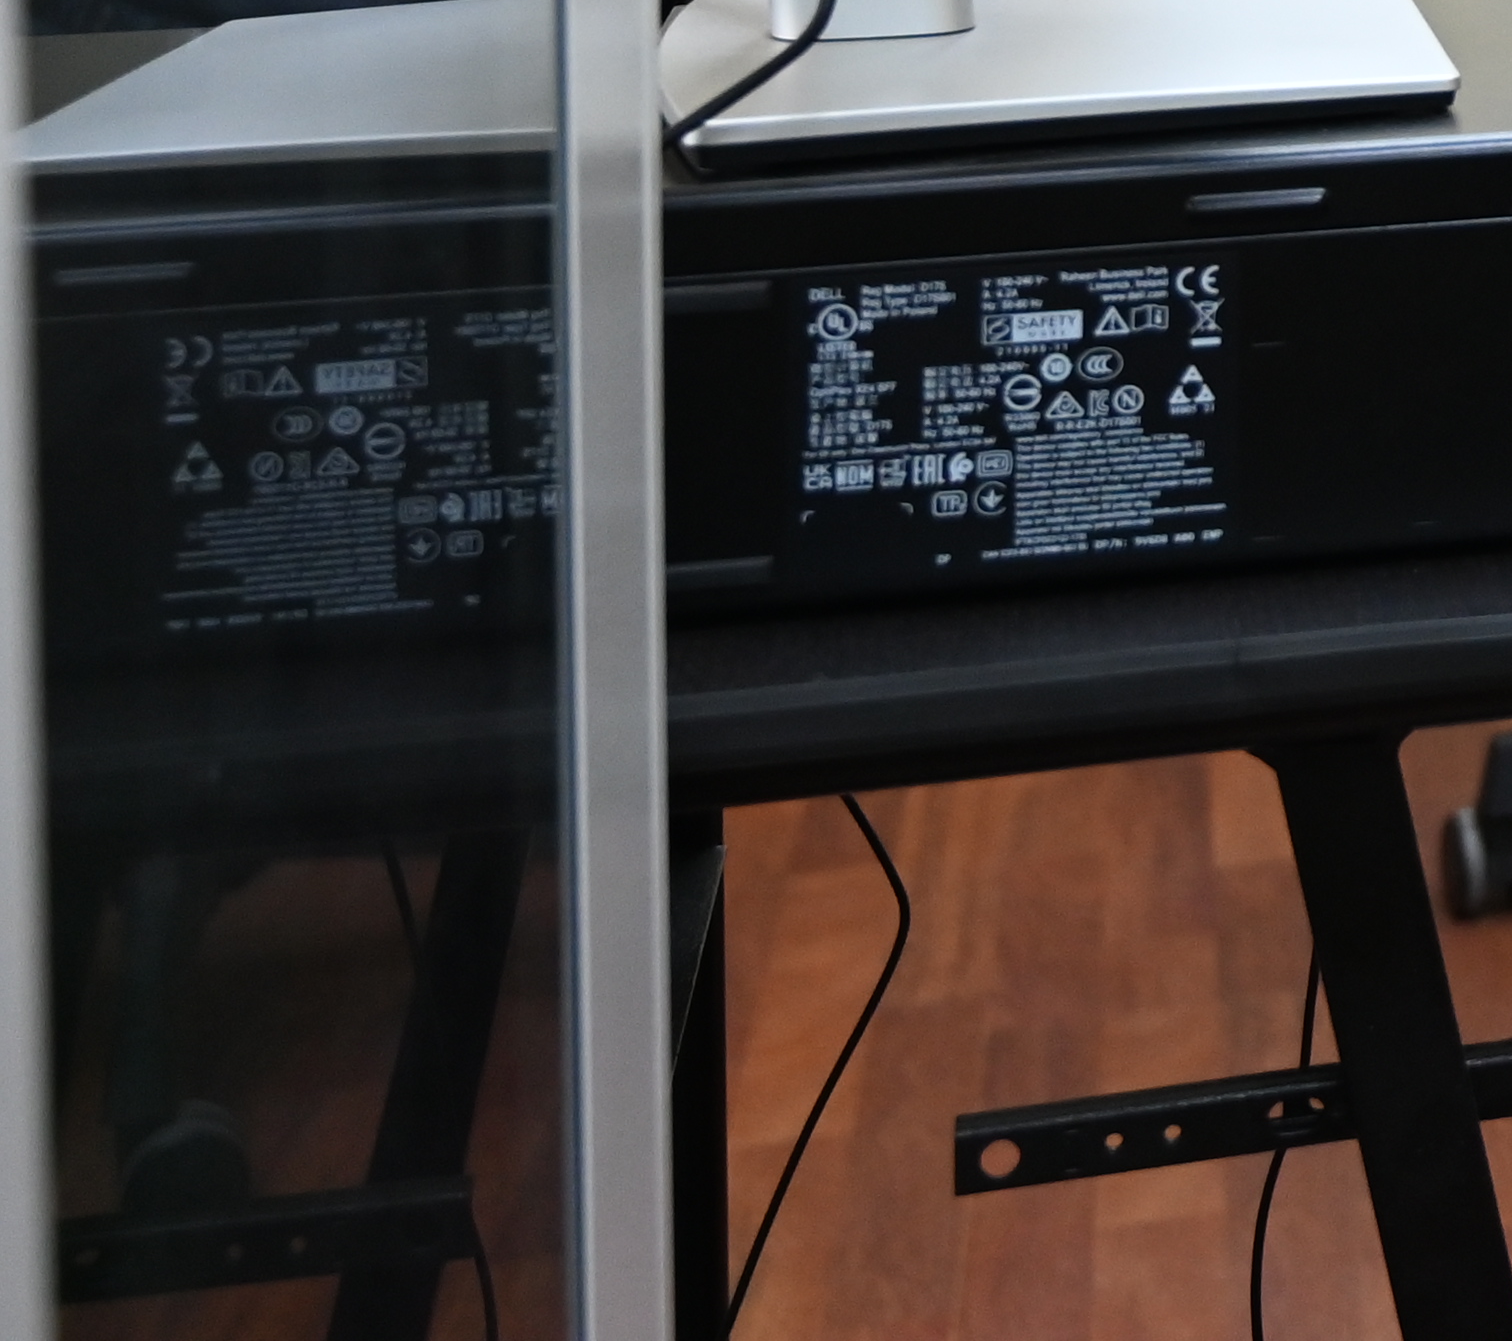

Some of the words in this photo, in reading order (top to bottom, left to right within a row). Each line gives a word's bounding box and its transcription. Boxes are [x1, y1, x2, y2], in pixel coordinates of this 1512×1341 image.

[1175, 264, 1221, 298] CE
[1016, 314, 1077, 330] SAFETY
[835, 465, 875, 487] NOM
